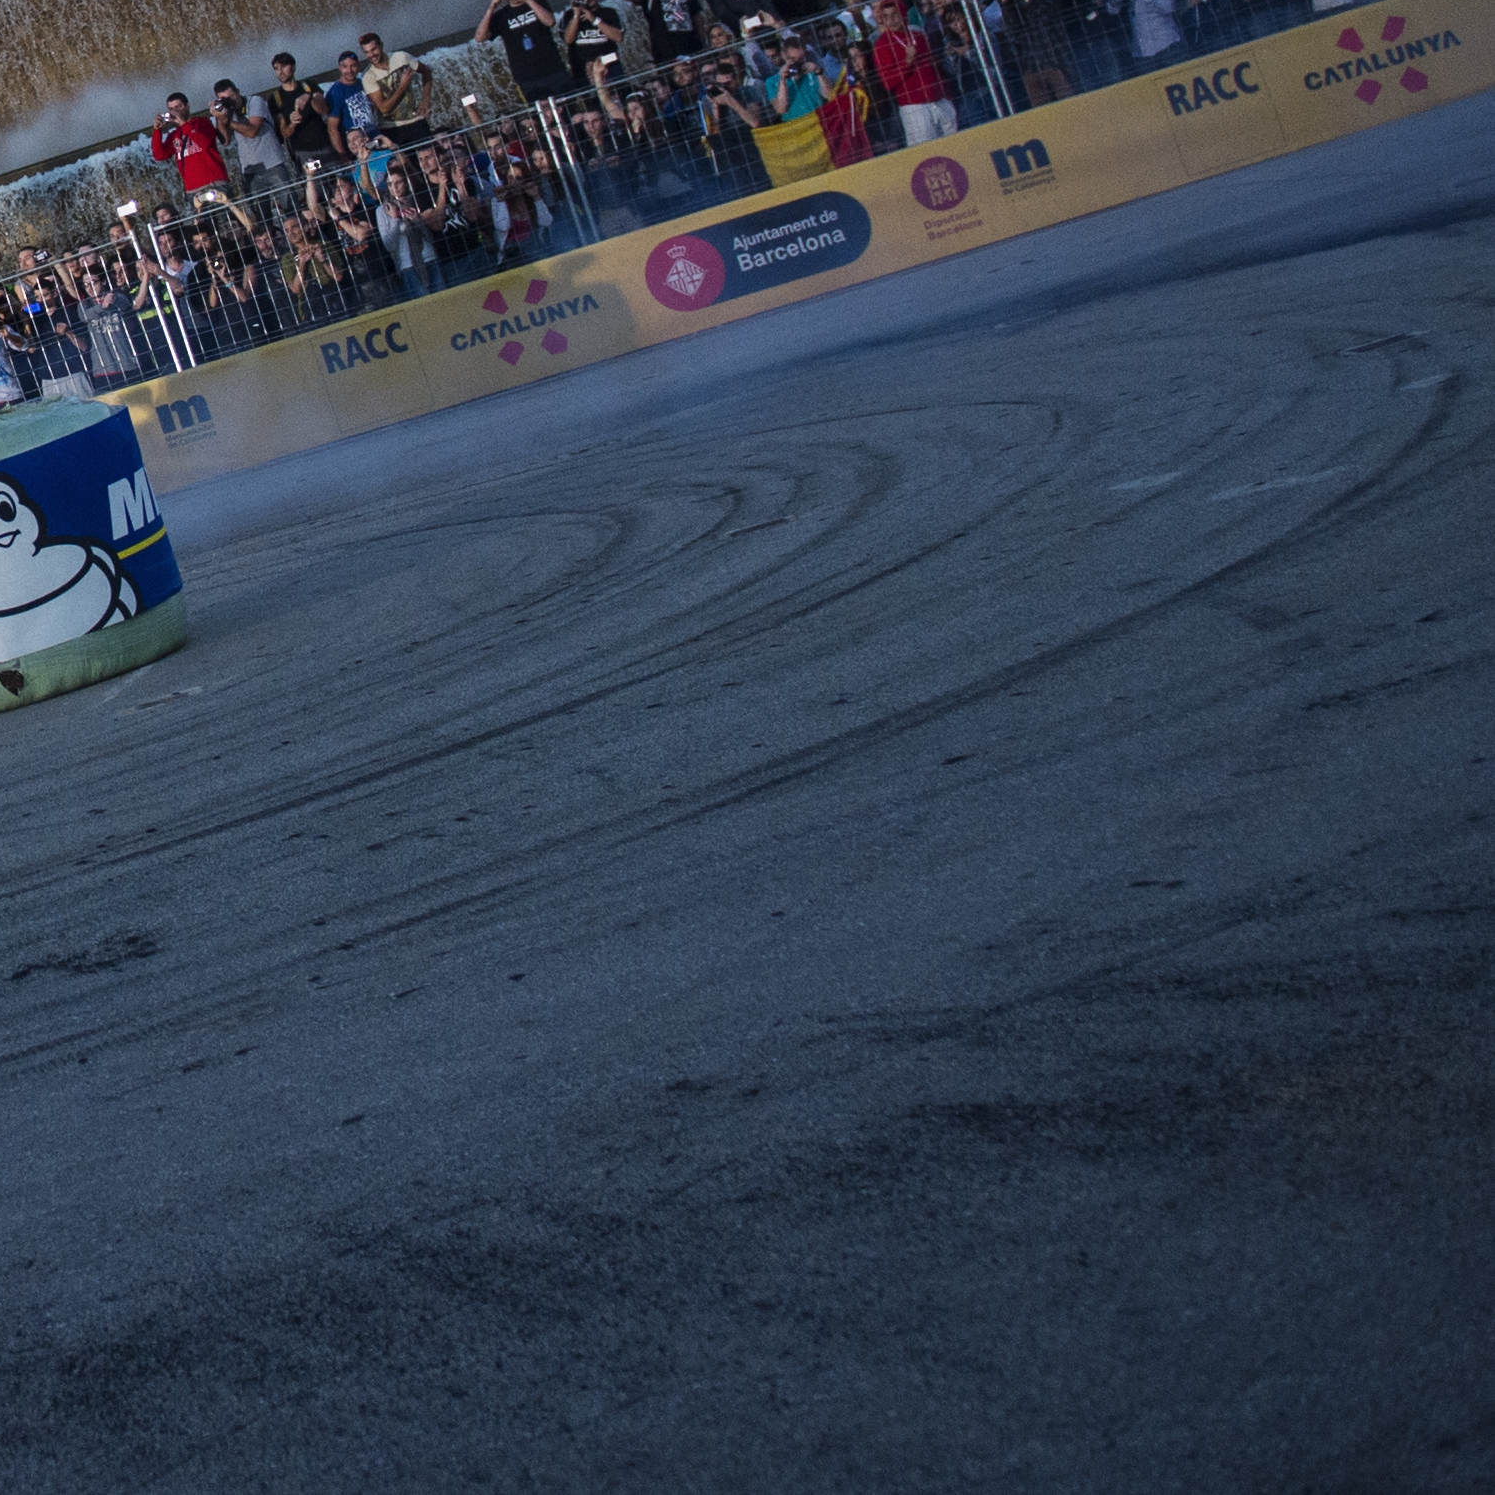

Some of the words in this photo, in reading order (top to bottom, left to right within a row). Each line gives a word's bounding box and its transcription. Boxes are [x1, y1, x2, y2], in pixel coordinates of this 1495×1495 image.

[1166, 62, 1259, 115] RACC
[1304, 30, 1461, 91] CATALUNYA
[990, 139, 1050, 180] m
[732, 215, 817, 251] Ajuntament
[819, 209, 838, 226] de
[736, 226, 845, 272] Barcelona
[927, 219, 983, 241] Barcelona
[320, 321, 408, 374] RACC
[450, 293, 599, 351] CATALUNYA
[109, 468, 156, 540] M
